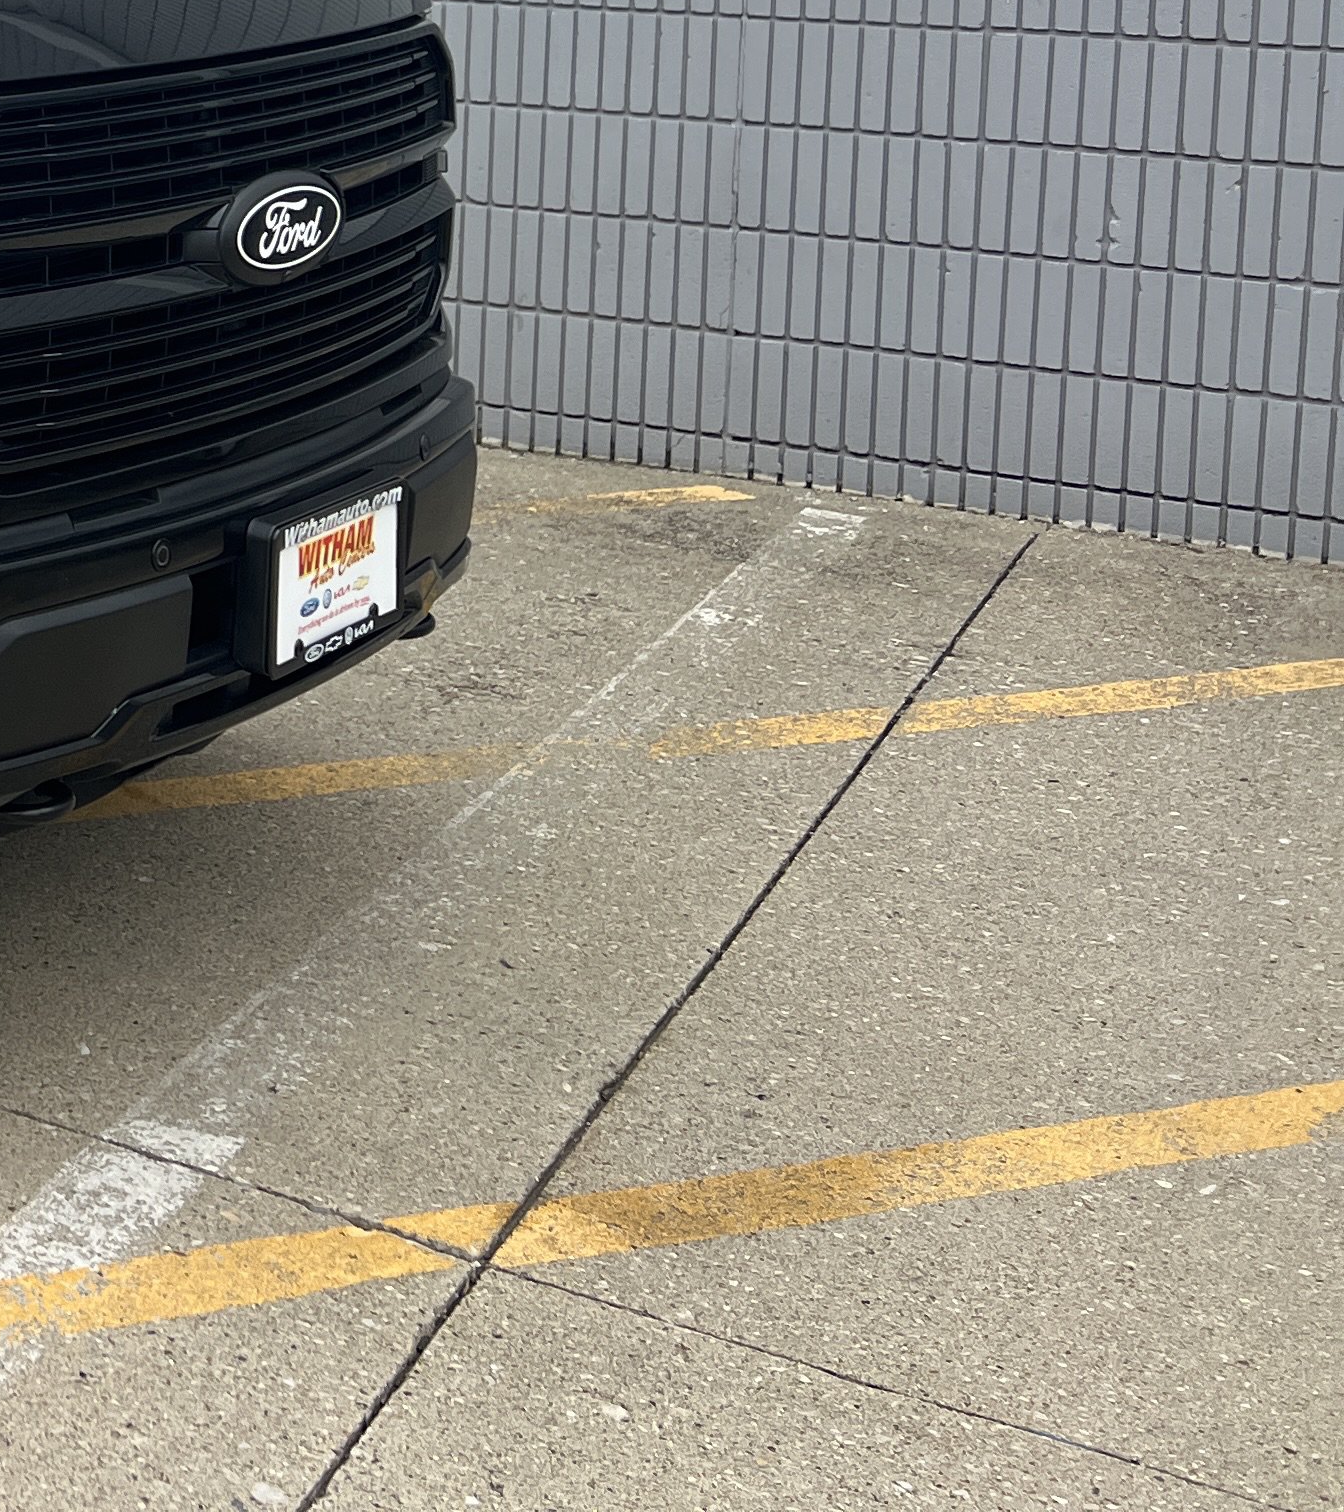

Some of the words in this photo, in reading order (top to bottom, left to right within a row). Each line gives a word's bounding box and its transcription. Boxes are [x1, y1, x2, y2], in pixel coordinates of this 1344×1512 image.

[258, 197, 324, 260] Ford
[284, 486, 403, 549] Withamauto.com
[297, 514, 375, 580] WITHAM
